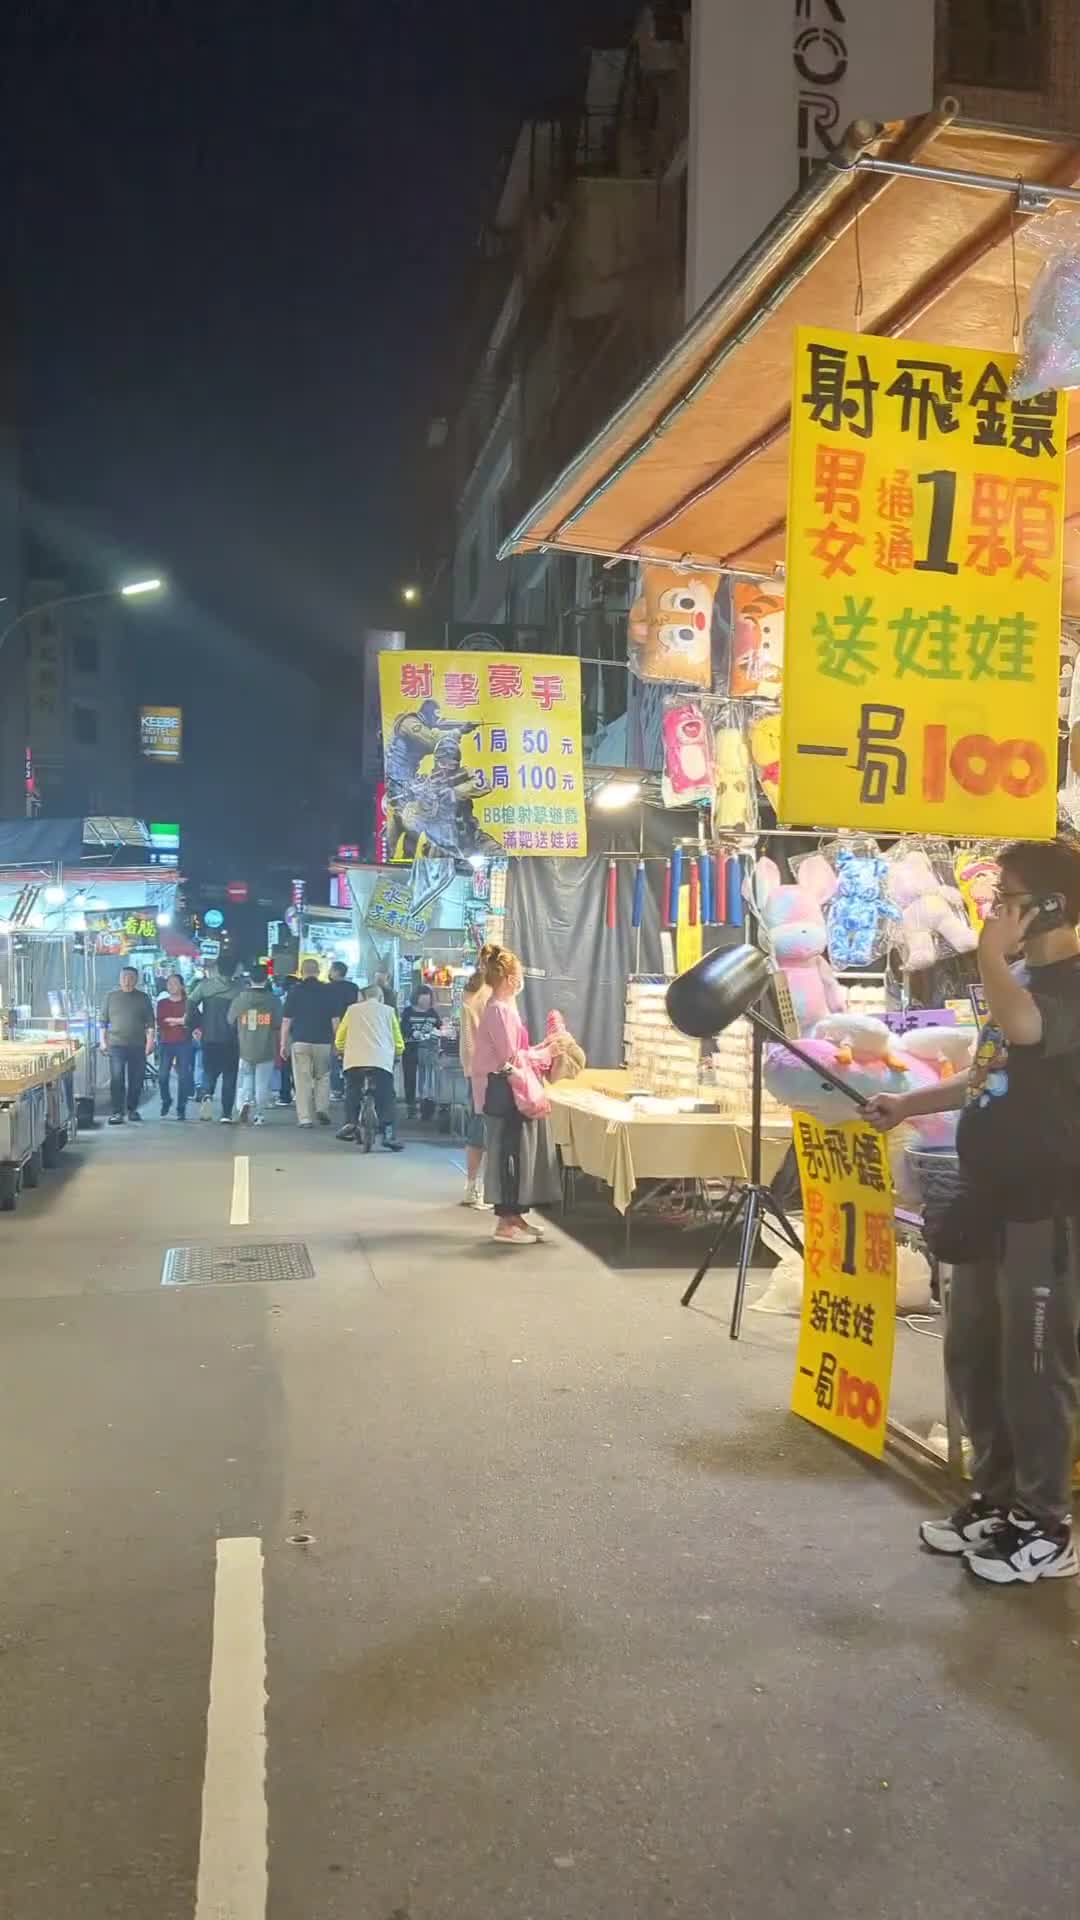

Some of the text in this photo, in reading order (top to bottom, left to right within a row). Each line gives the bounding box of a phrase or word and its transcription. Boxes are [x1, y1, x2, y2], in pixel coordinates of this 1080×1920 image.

[793, 0, 849, 183] OR
[811, 595, 1040, 686] 送娃娃
[400, 663, 564, 711] 射擊豪手
